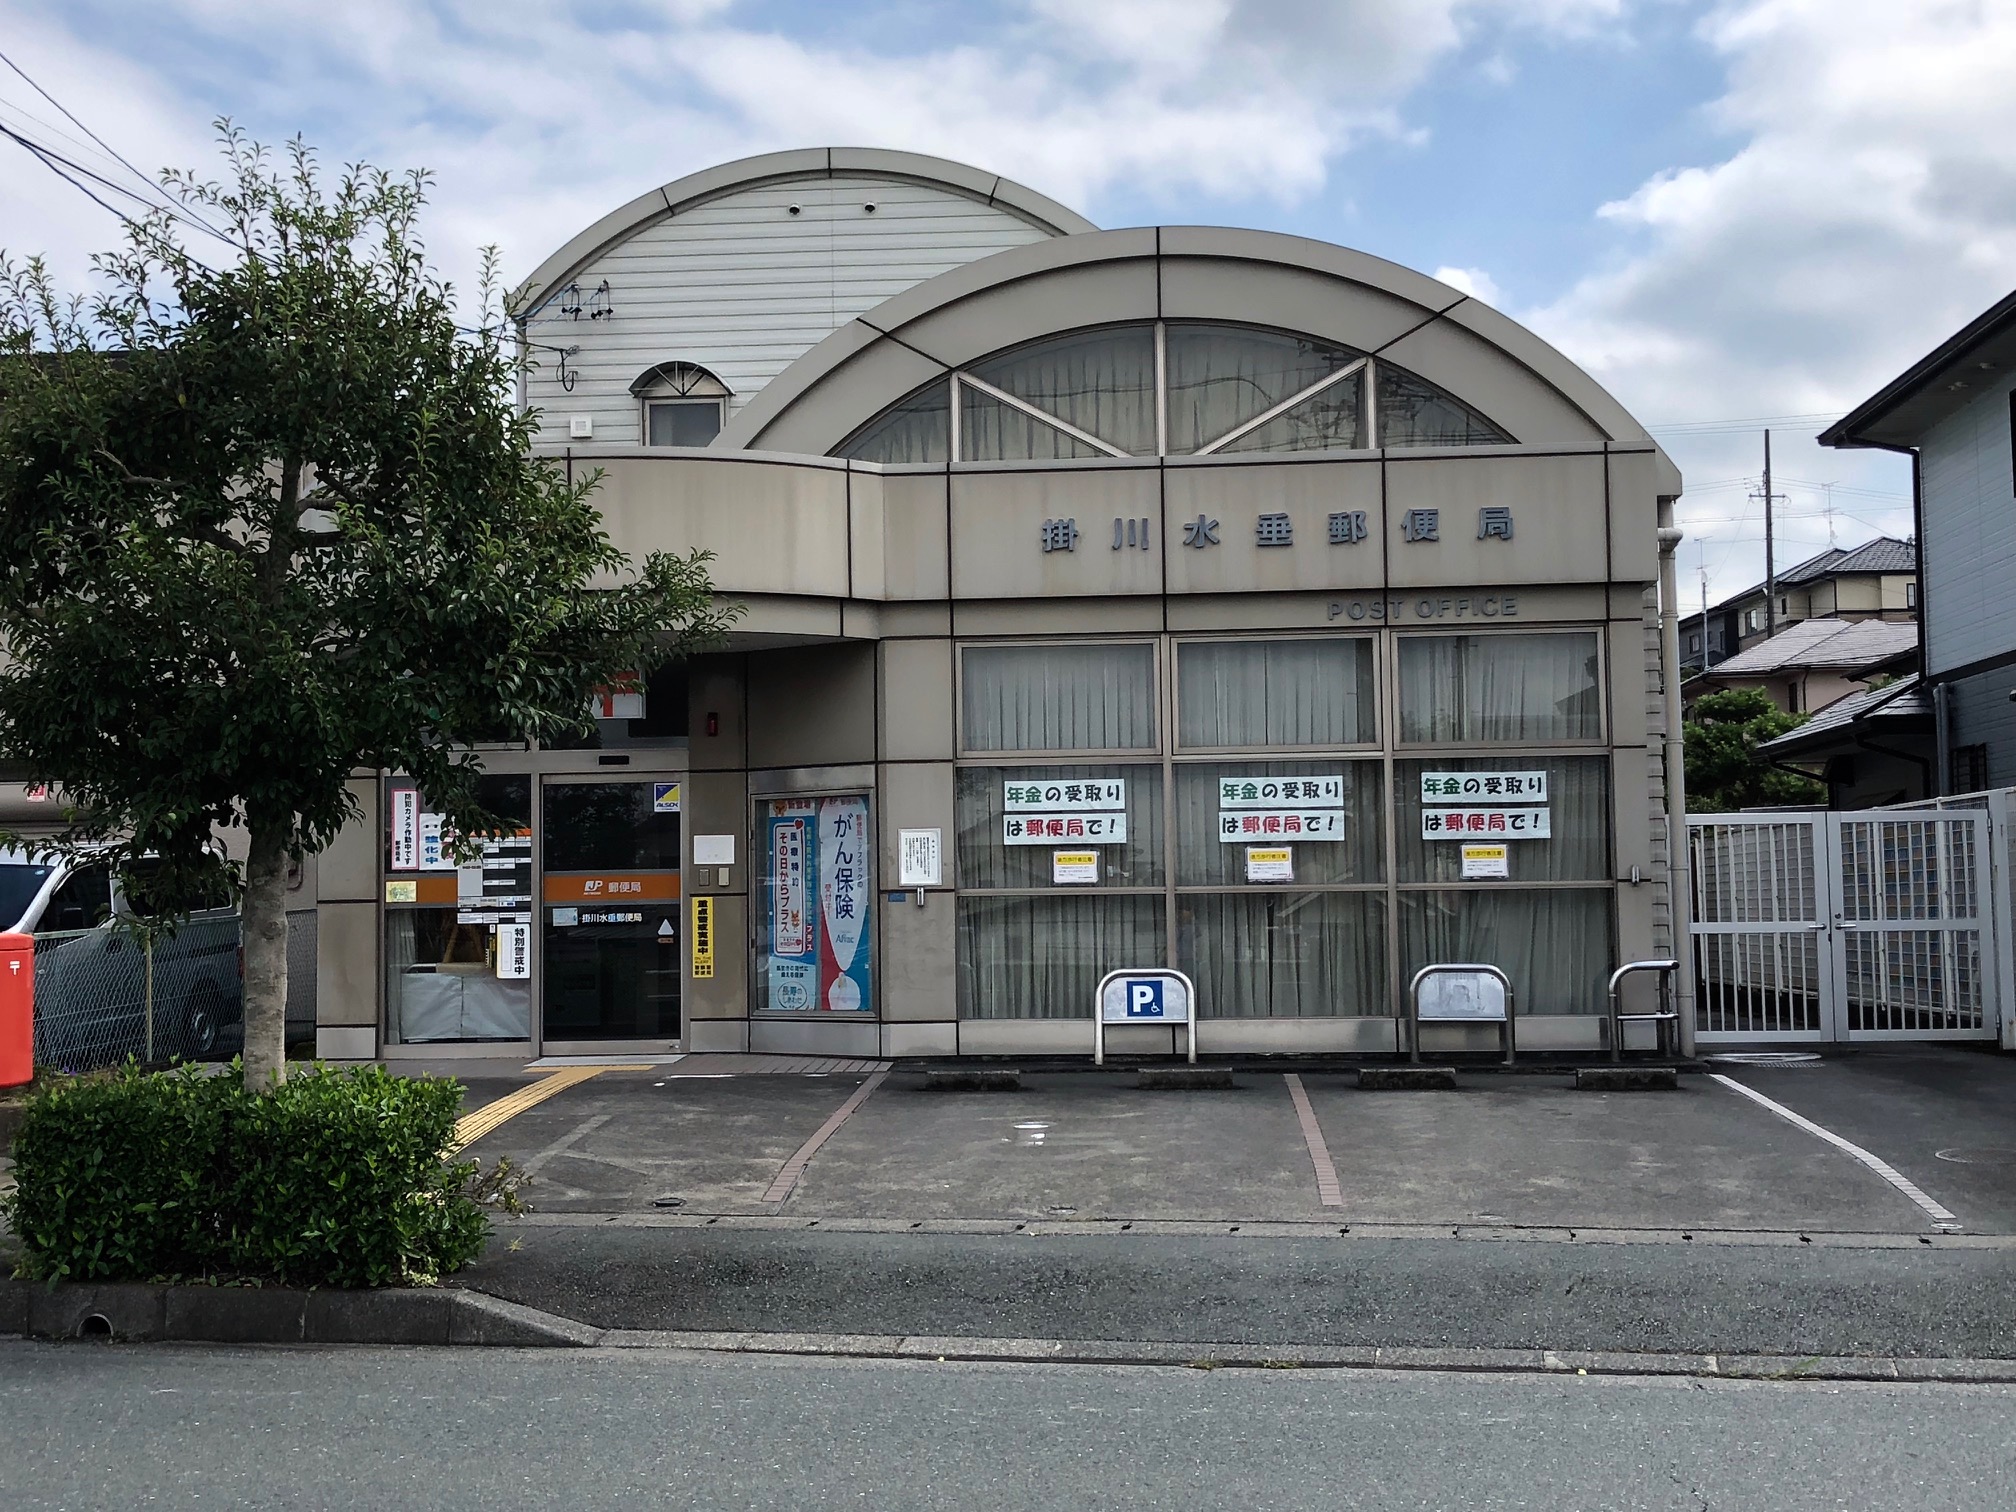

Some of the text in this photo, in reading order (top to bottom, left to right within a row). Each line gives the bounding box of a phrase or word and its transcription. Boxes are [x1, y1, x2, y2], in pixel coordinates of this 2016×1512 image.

[1042, 506, 1514, 552] 掛川水垂郵便局
[1327, 598, 1518, 620] POST OFFICE
[1006, 785, 1120, 804] 年金の受取り
[1222, 781, 1339, 800] 年金の受取り
[1423, 777, 1541, 796] 年金の受取り
[1006, 818, 1115, 837] は郵便局で!
[1222, 815, 1334, 834] は郵便局で!
[1424, 813, 1539, 832] は郵便局で!
[834, 813, 854, 919] がん保険
[608, 882, 641, 893] 郵便局
[779, 832, 789, 933] その日からプラス
[582, 913, 642, 923] 掛川水垂郵便局
[514, 928, 525, 975] 特別警戒中
[1132, 985, 1154, 1013] P
